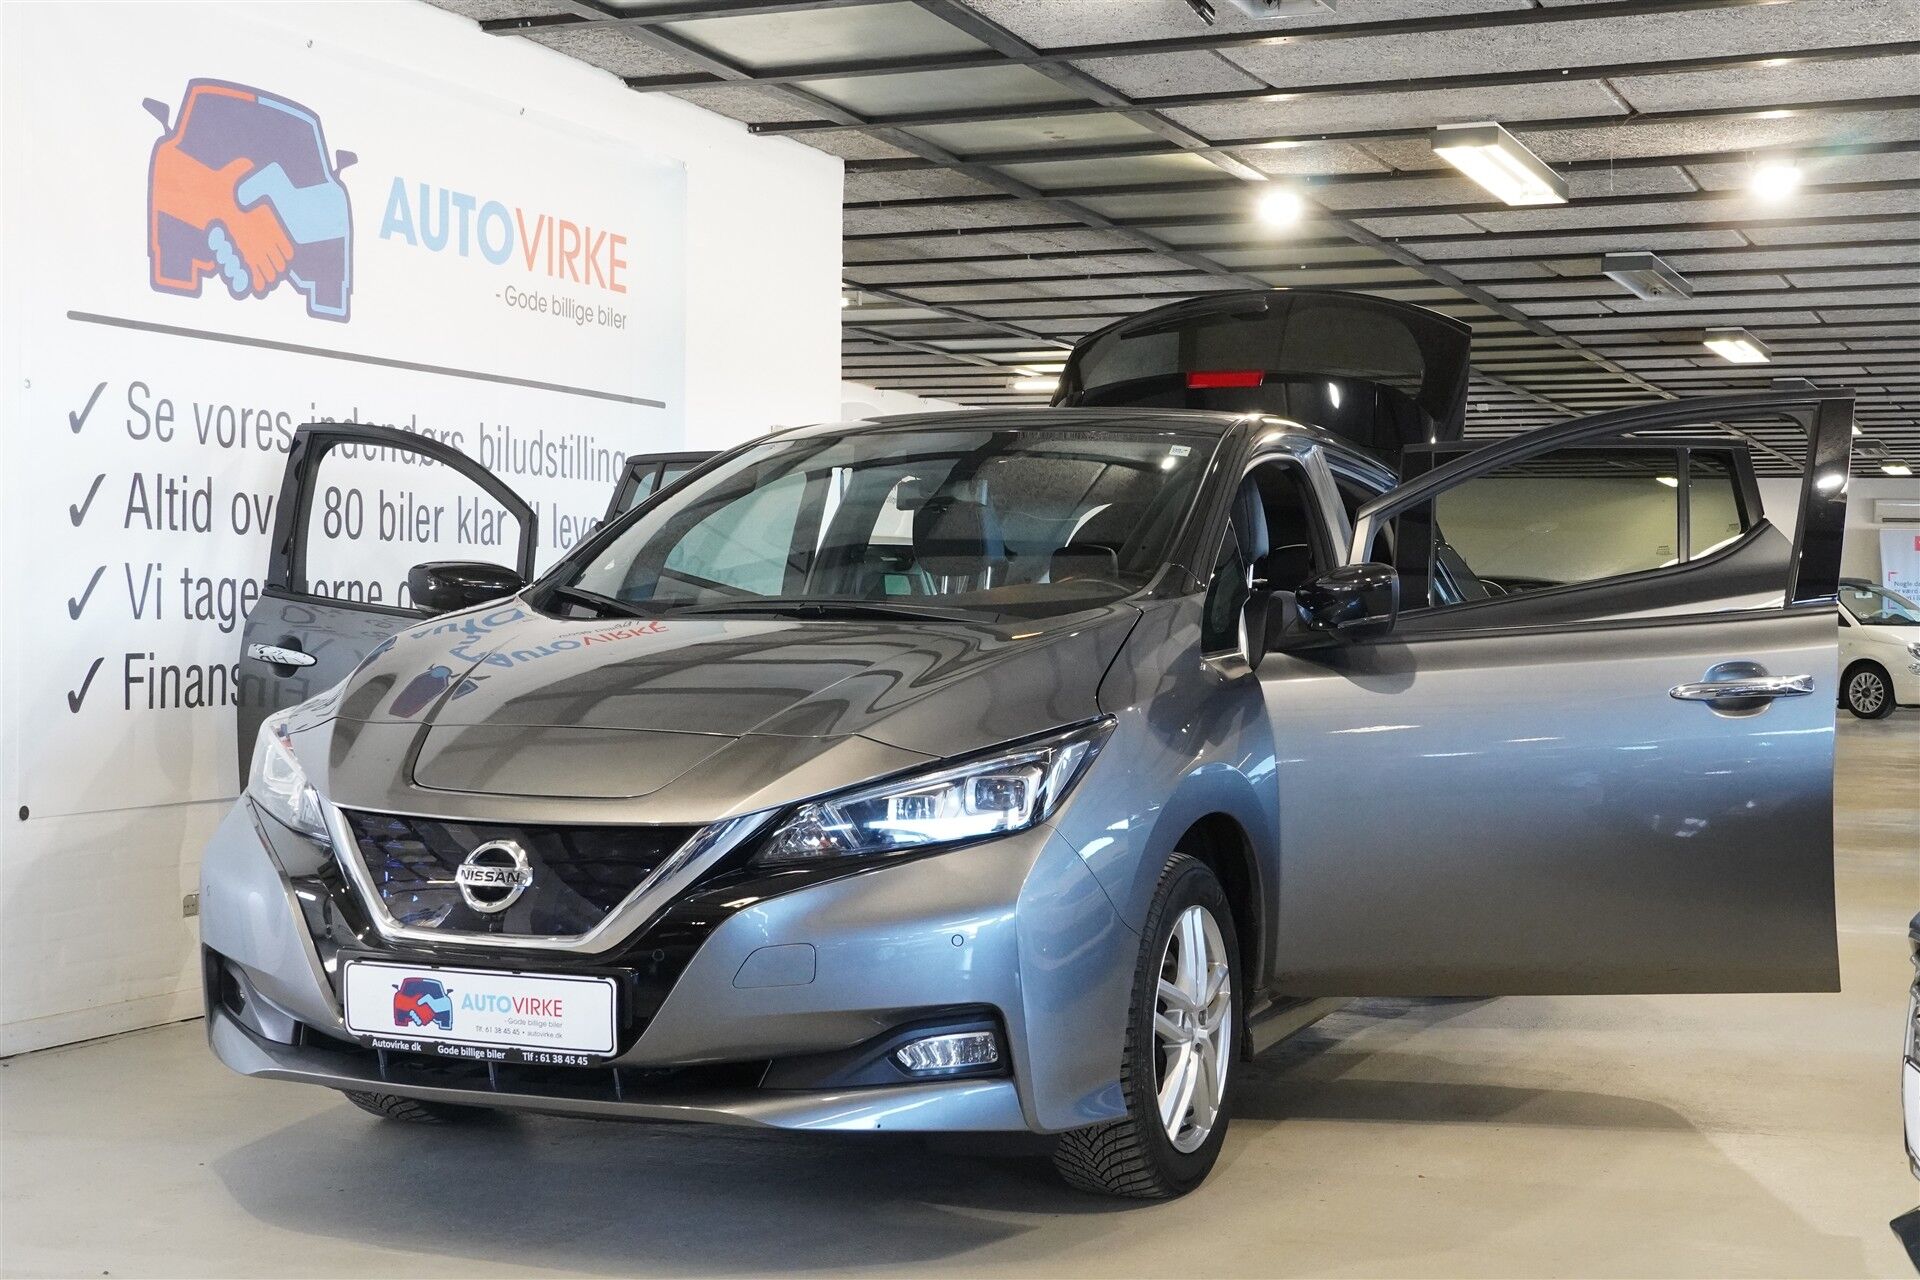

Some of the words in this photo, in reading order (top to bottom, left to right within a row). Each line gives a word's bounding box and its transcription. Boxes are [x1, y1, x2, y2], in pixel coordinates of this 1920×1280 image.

[379, 176, 627, 294] AUTOVIRKE
[505, 285, 548, 313] Gode
[552, 295, 594, 326] billige
[598, 305, 627, 330] biler
[127, 381, 174, 442] Se
[193, 402, 292, 453] vores
[124, 472, 212, 533] Altid
[323, 487, 363, 540] 80
[380, 490, 444, 543] biler
[458, 496, 507, 545] klar
[125, 563, 162, 620] Vi
[180, 568, 267, 633] tage
[461, 870, 520, 883] NISSAN
[461, 993, 563, 1017] AUTOVIRKE
[508, 1018, 526, 1026] Gode
[528, 1018, 547, 1028] billige
[549, 1020, 563, 1028] biler
[372, 1039, 409, 1050] Autovirke
[437, 1045, 459, 1056] Gode
[461, 1046, 485, 1059] billige
[487, 1049, 506, 1060] biler
[522, 1052, 534, 1061] Tlf
[540, 1053, 551, 1063] 61
[552, 1054, 563, 1064] 38
[564, 1055, 575, 1065] 45
[577, 1056, 588, 1066] 45
